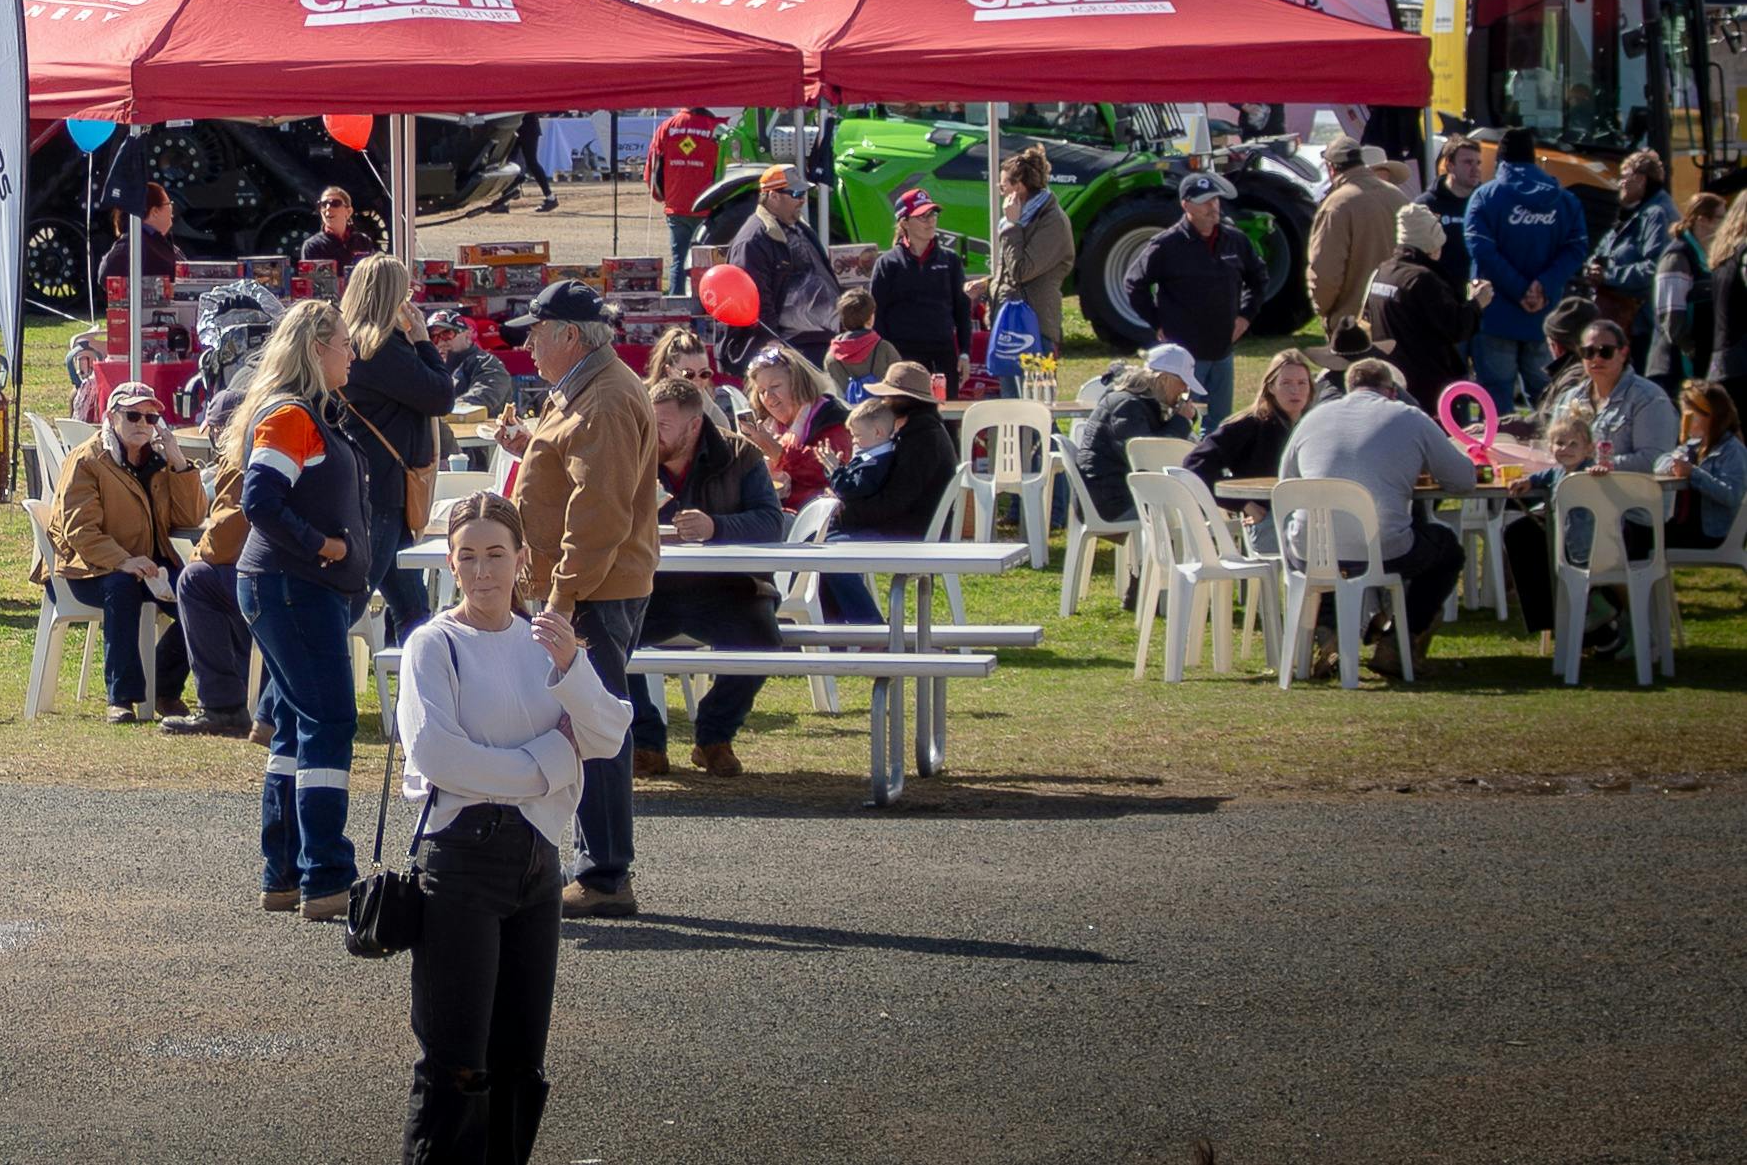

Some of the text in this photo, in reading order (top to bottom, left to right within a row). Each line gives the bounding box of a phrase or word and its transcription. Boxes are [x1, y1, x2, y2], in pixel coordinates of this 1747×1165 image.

[410, 6, 516, 21] AGRICULTURE
[1070, 2, 1168, 14] AGRICULTURE
[1508, 204, 1558, 226] Ford
